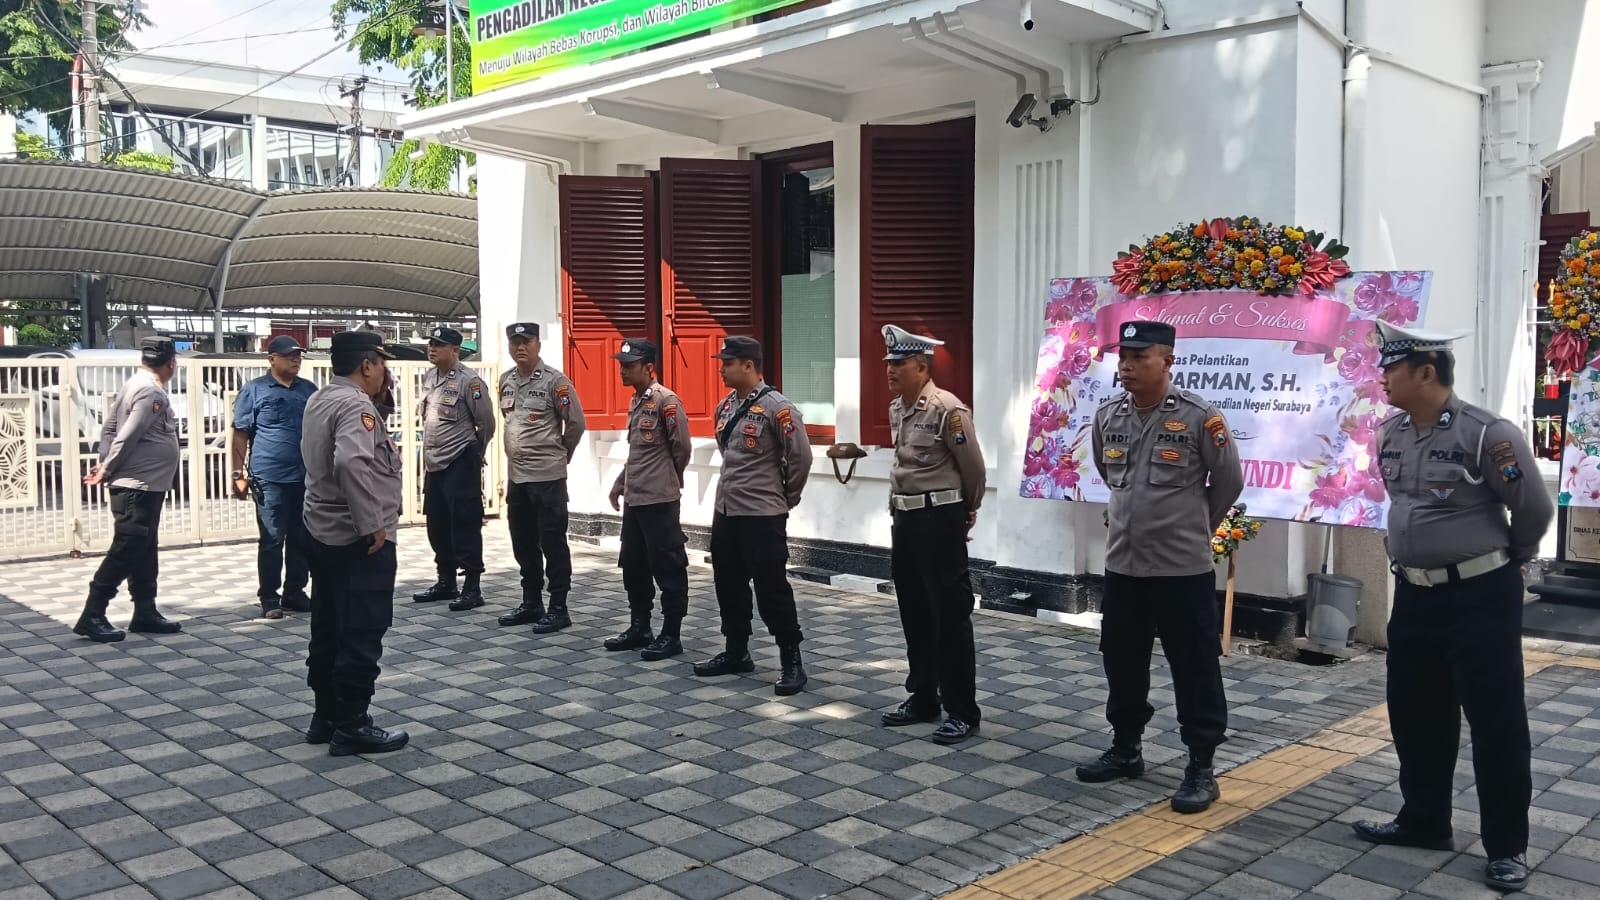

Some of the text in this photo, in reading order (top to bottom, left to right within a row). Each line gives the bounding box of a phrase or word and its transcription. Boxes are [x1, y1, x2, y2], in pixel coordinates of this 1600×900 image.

[479, 57, 511, 75] Menuju
[513, 44, 547, 64] Wilayah
[550, 36, 578, 54] Bebas
[580, 23, 619, 45] Korupsi,
[622, 15, 642, 33] dan
[644, 1, 688, 26] Wilayah
[1209, 303, 1233, 326] &
[1234, 302, 1309, 331] Sukses
[1189, 353, 1249, 367] Pelantikan
[1261, 372, 1302, 392] S.H.
[1243, 398, 1272, 414] Negeri
[1272, 398, 1312, 415] Surabaya
[1105, 434, 1129, 443] ARDI
[1157, 433, 1189, 444] POLRI
[1430, 449, 1464, 462] POLRI
